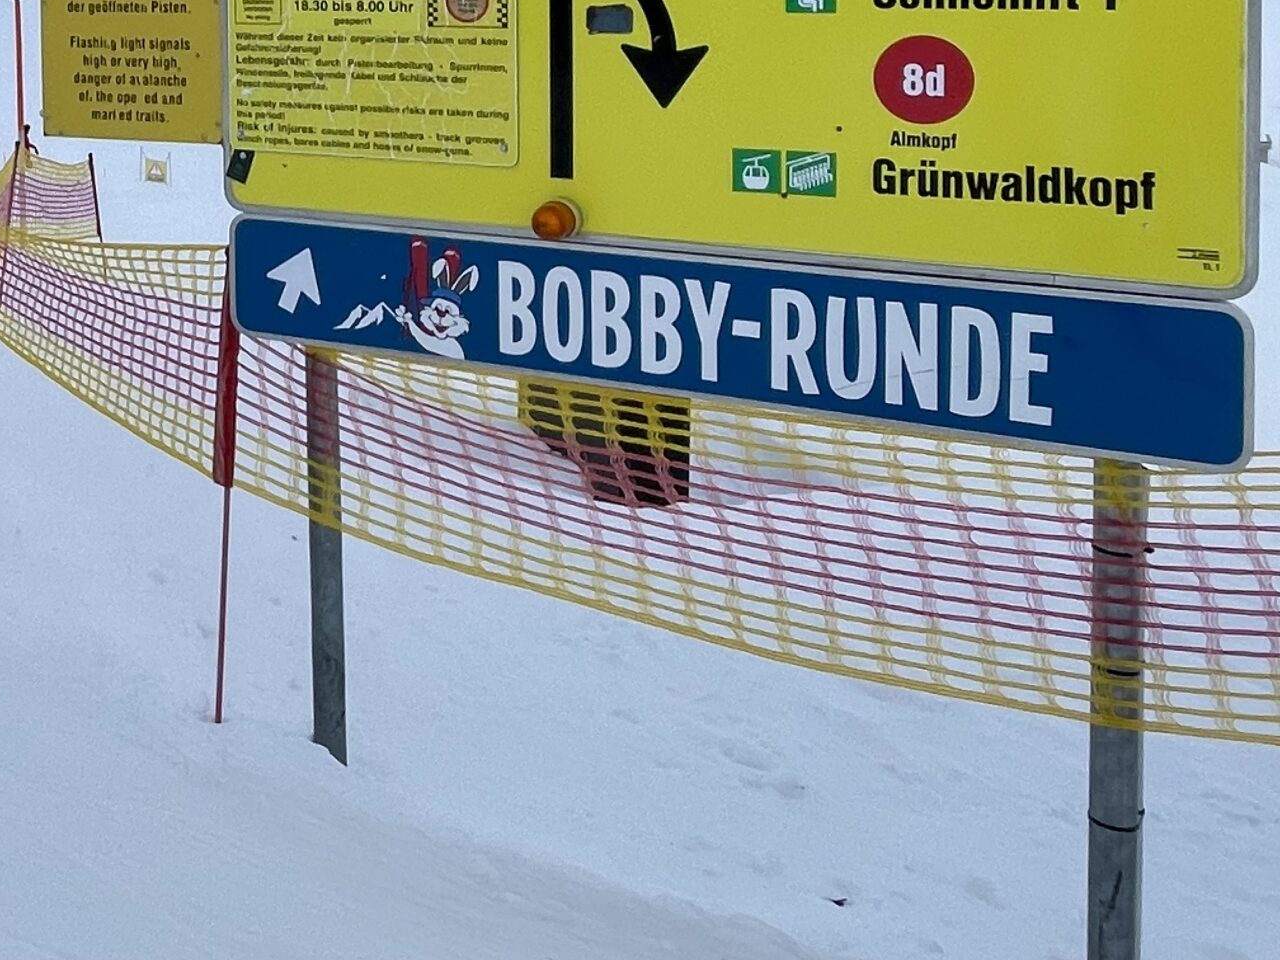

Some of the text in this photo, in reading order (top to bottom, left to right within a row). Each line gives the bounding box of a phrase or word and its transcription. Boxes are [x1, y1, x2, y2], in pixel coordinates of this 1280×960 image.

[67, 1, 85, 13] der
[294, 0, 414, 13] 18.30 bis 8.00 Uhr
[120, 37, 146, 51] light
[149, 38, 191, 51] signals
[83, 55, 107, 69] high
[111, 57, 121, 67] or
[125, 57, 149, 70] very
[74, 72, 111, 86] danger
[115, 74, 126, 85] of
[902, 63, 946, 97] 8d
[96, 91, 113, 103] the
[117, 92, 158, 104] opeed
[162, 93, 183, 105] and
[890, 131, 958, 150] Almkopf
[872, 158, 1157, 216] Grünwaldkopf
[497, 260, 1054, 427] BOBBY-RUNDE
